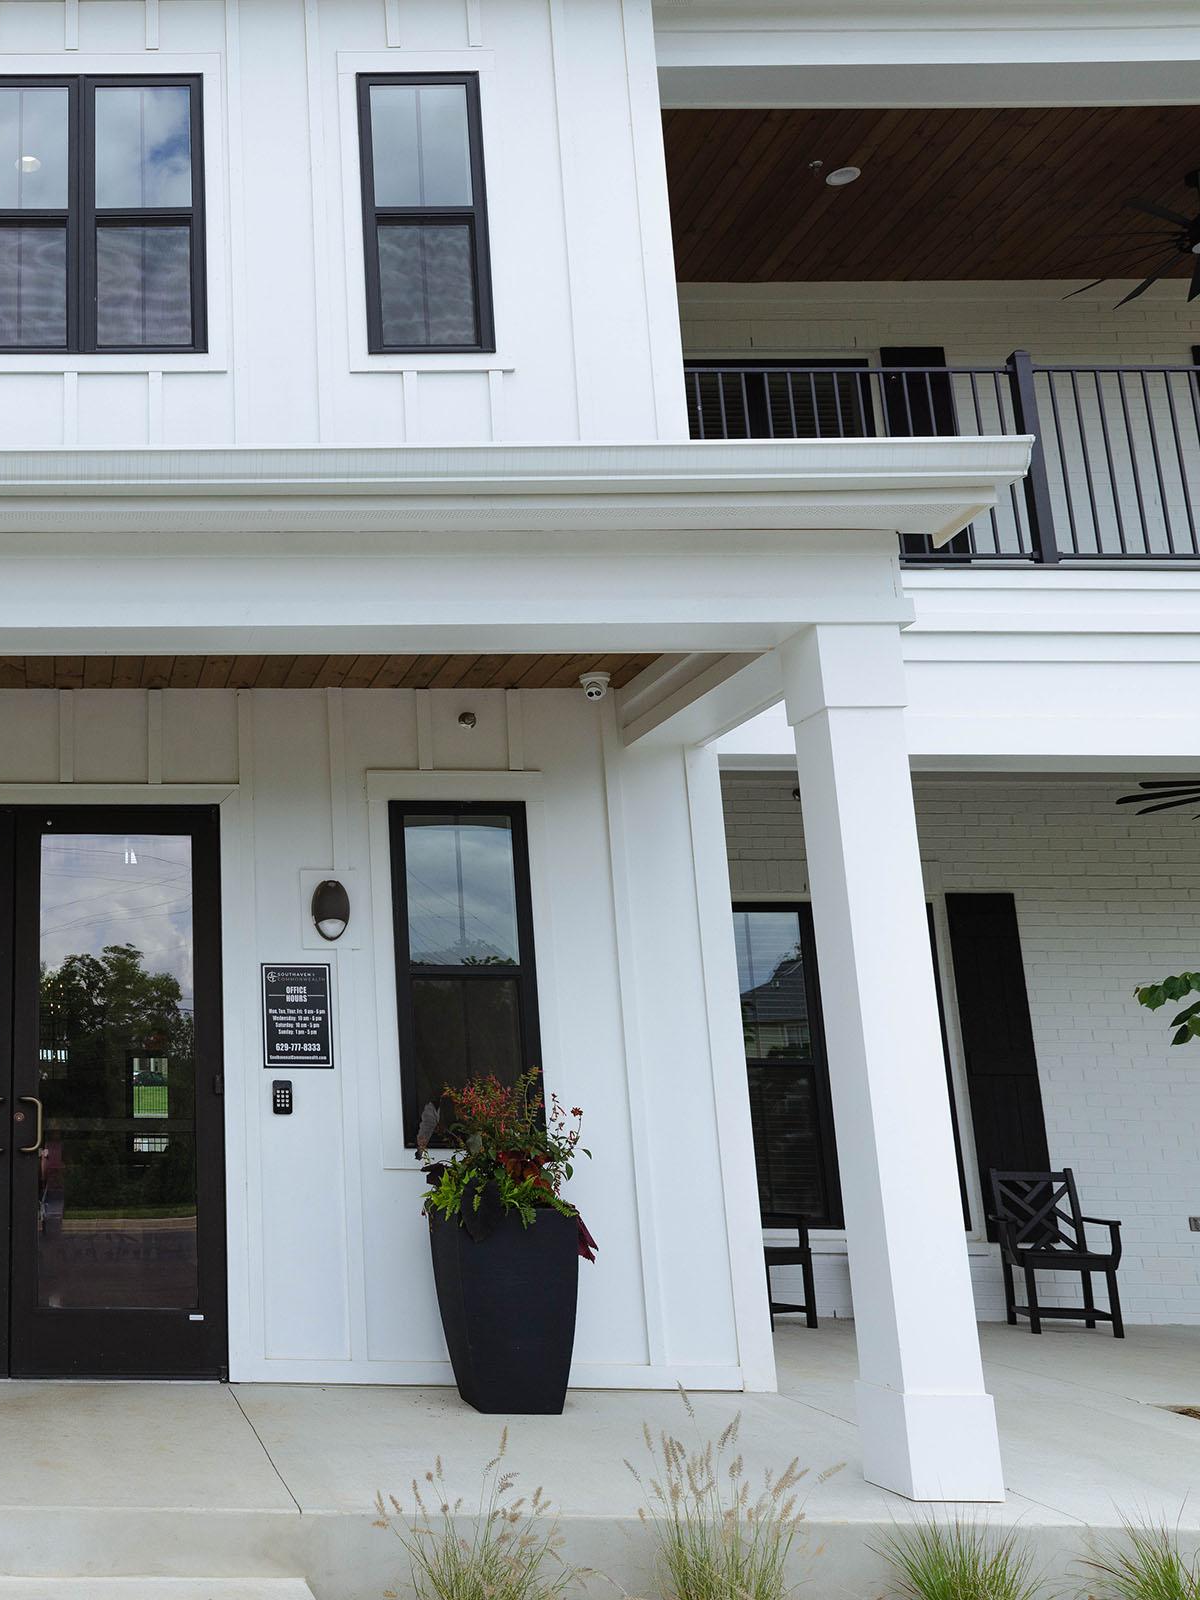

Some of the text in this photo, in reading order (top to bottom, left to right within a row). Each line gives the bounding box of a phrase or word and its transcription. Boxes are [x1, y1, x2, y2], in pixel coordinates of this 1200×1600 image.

[285, 986, 307, 994] OFFICE
[285, 994, 308, 1003] HOURS
[275, 1043, 321, 1051] 629-777-8333
